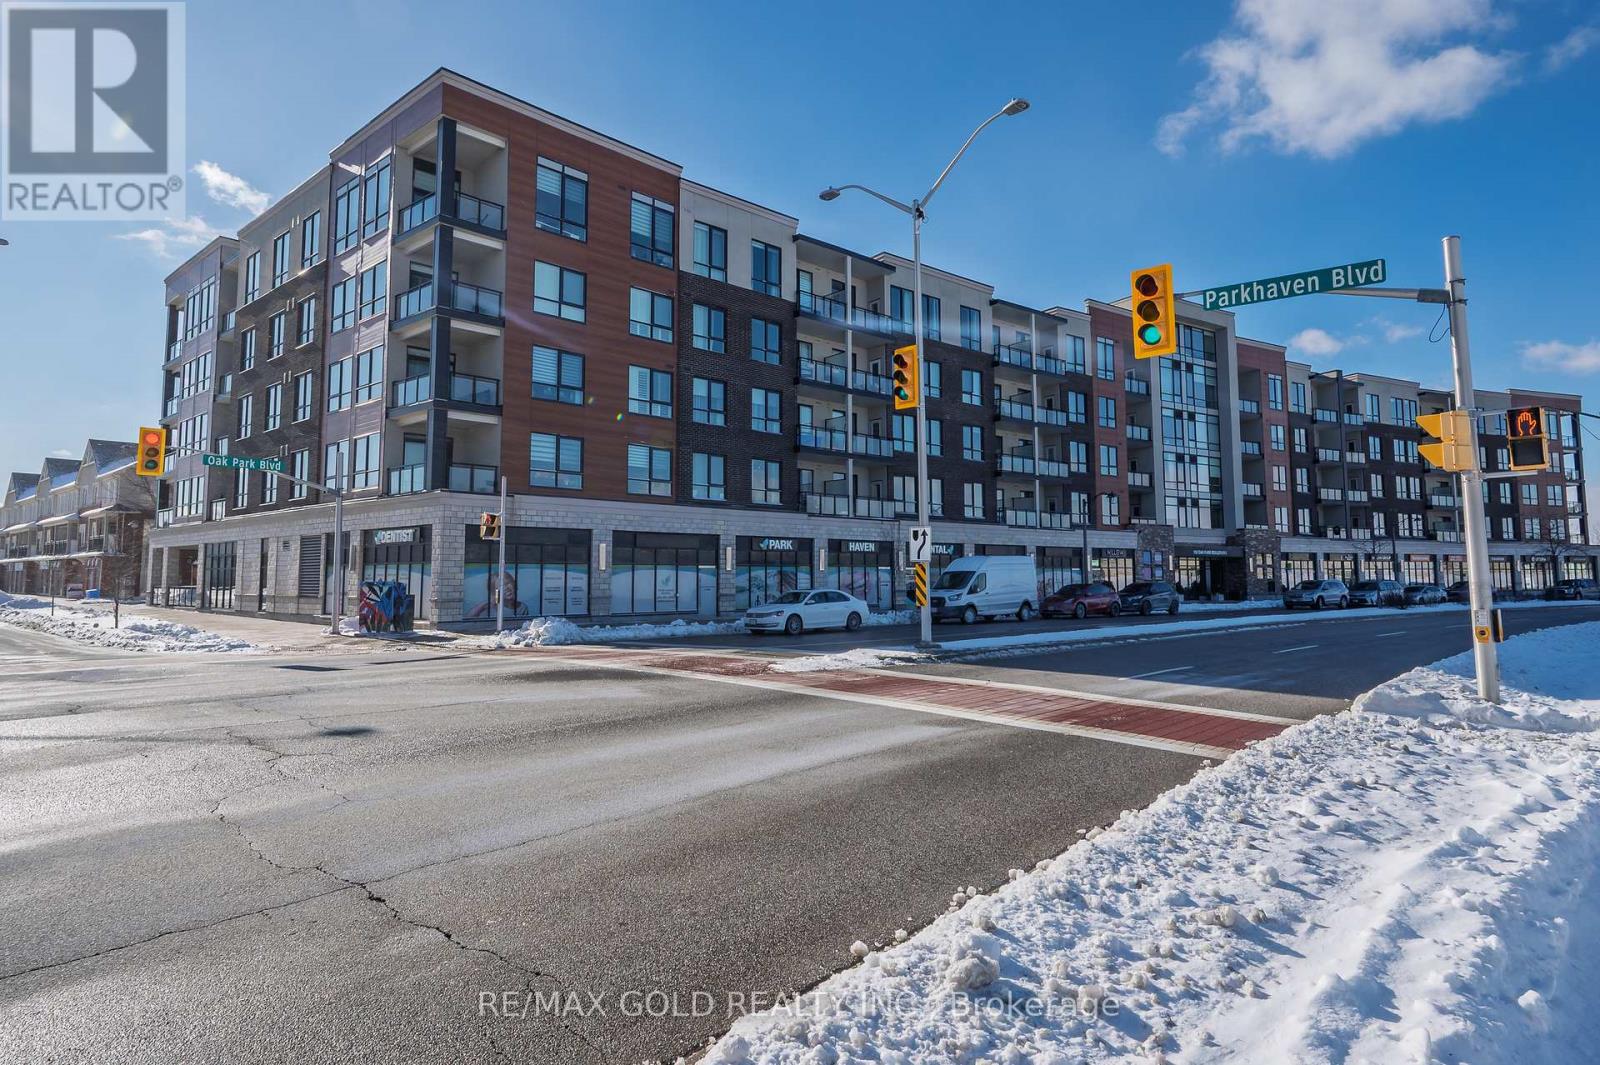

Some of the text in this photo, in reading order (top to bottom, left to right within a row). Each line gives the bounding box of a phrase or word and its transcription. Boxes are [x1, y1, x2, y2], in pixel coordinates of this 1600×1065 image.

[1206, 260, 1384, 309] Parkhaven Blvd
[207, 455, 281, 471] Oak Park Blvd
[769, 539, 793, 550] PARK
[849, 541, 875, 552] HAVEN
